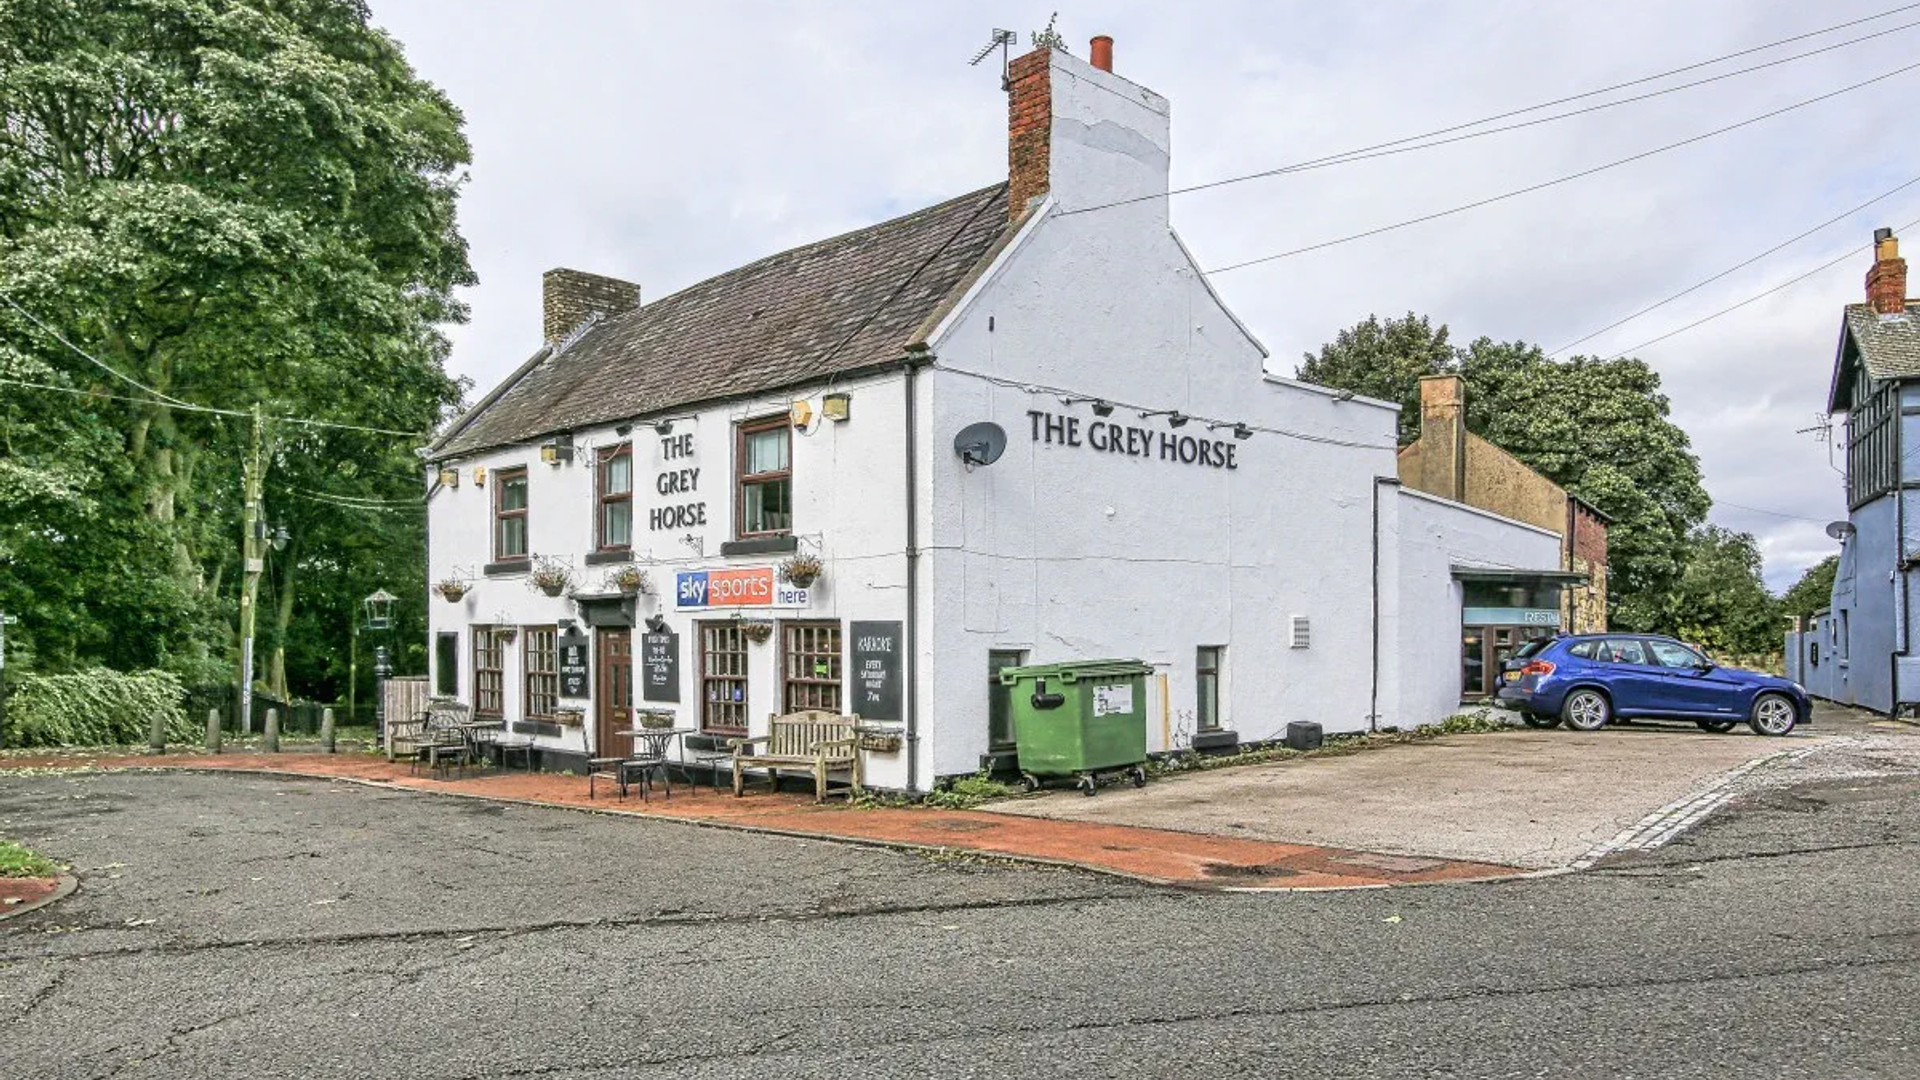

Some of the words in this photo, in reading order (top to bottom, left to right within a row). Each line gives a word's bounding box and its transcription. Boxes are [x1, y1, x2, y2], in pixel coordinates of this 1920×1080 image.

[661, 433, 693, 460] THE
[1027, 410, 1082, 447] THE
[1088, 421, 1154, 457] GREY
[1160, 432, 1238, 470] HORSE
[657, 468, 700, 496] GREY
[650, 502, 707, 531] HORSE
[680, 576, 706, 604] sky
[711, 576, 768, 601] sports
[778, 588, 807, 604] here
